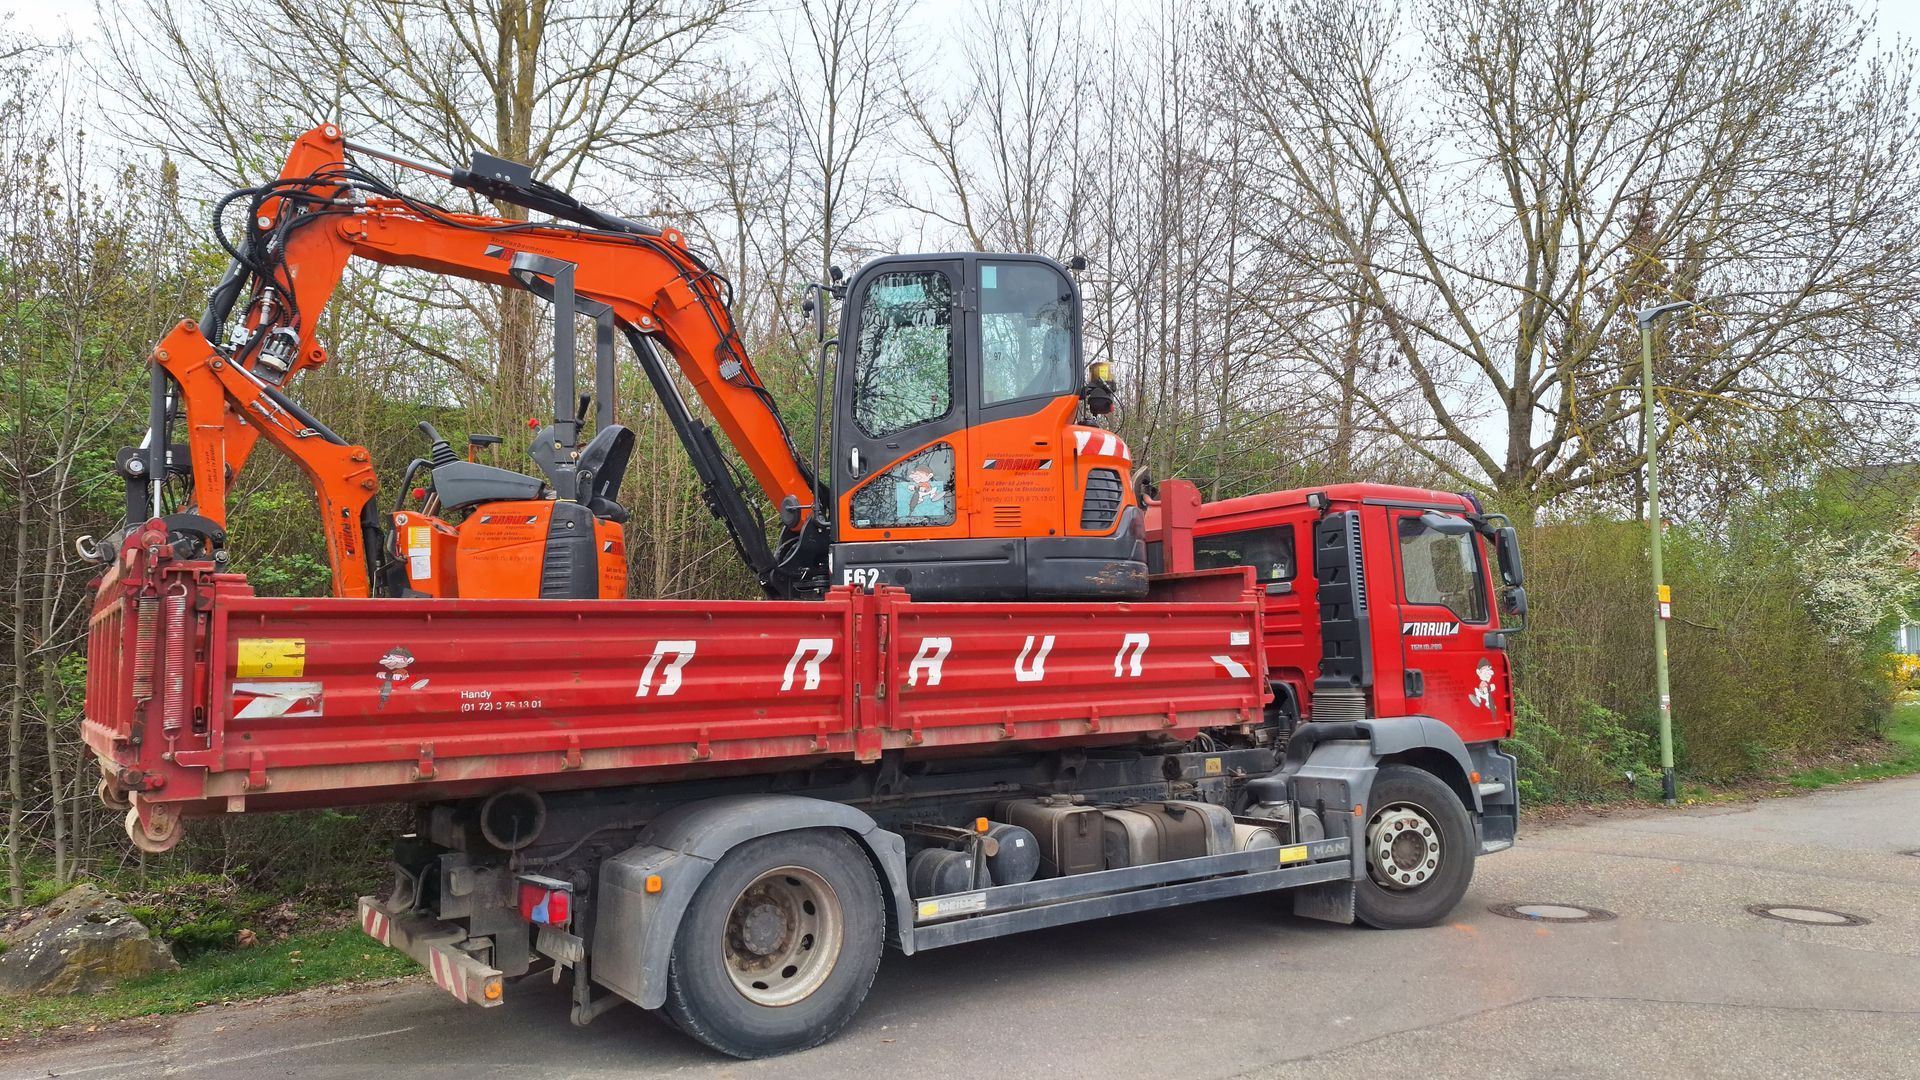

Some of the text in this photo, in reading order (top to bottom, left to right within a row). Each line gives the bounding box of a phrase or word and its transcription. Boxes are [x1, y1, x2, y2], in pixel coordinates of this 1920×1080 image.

[1412, 622, 1451, 636] BRAUN
[461, 690, 492, 700] Handy
[461, 703, 475, 713] (01
[478, 702, 493, 711] 72)
[531, 700, 542, 709] 01
[1313, 842, 1345, 855] MAN
